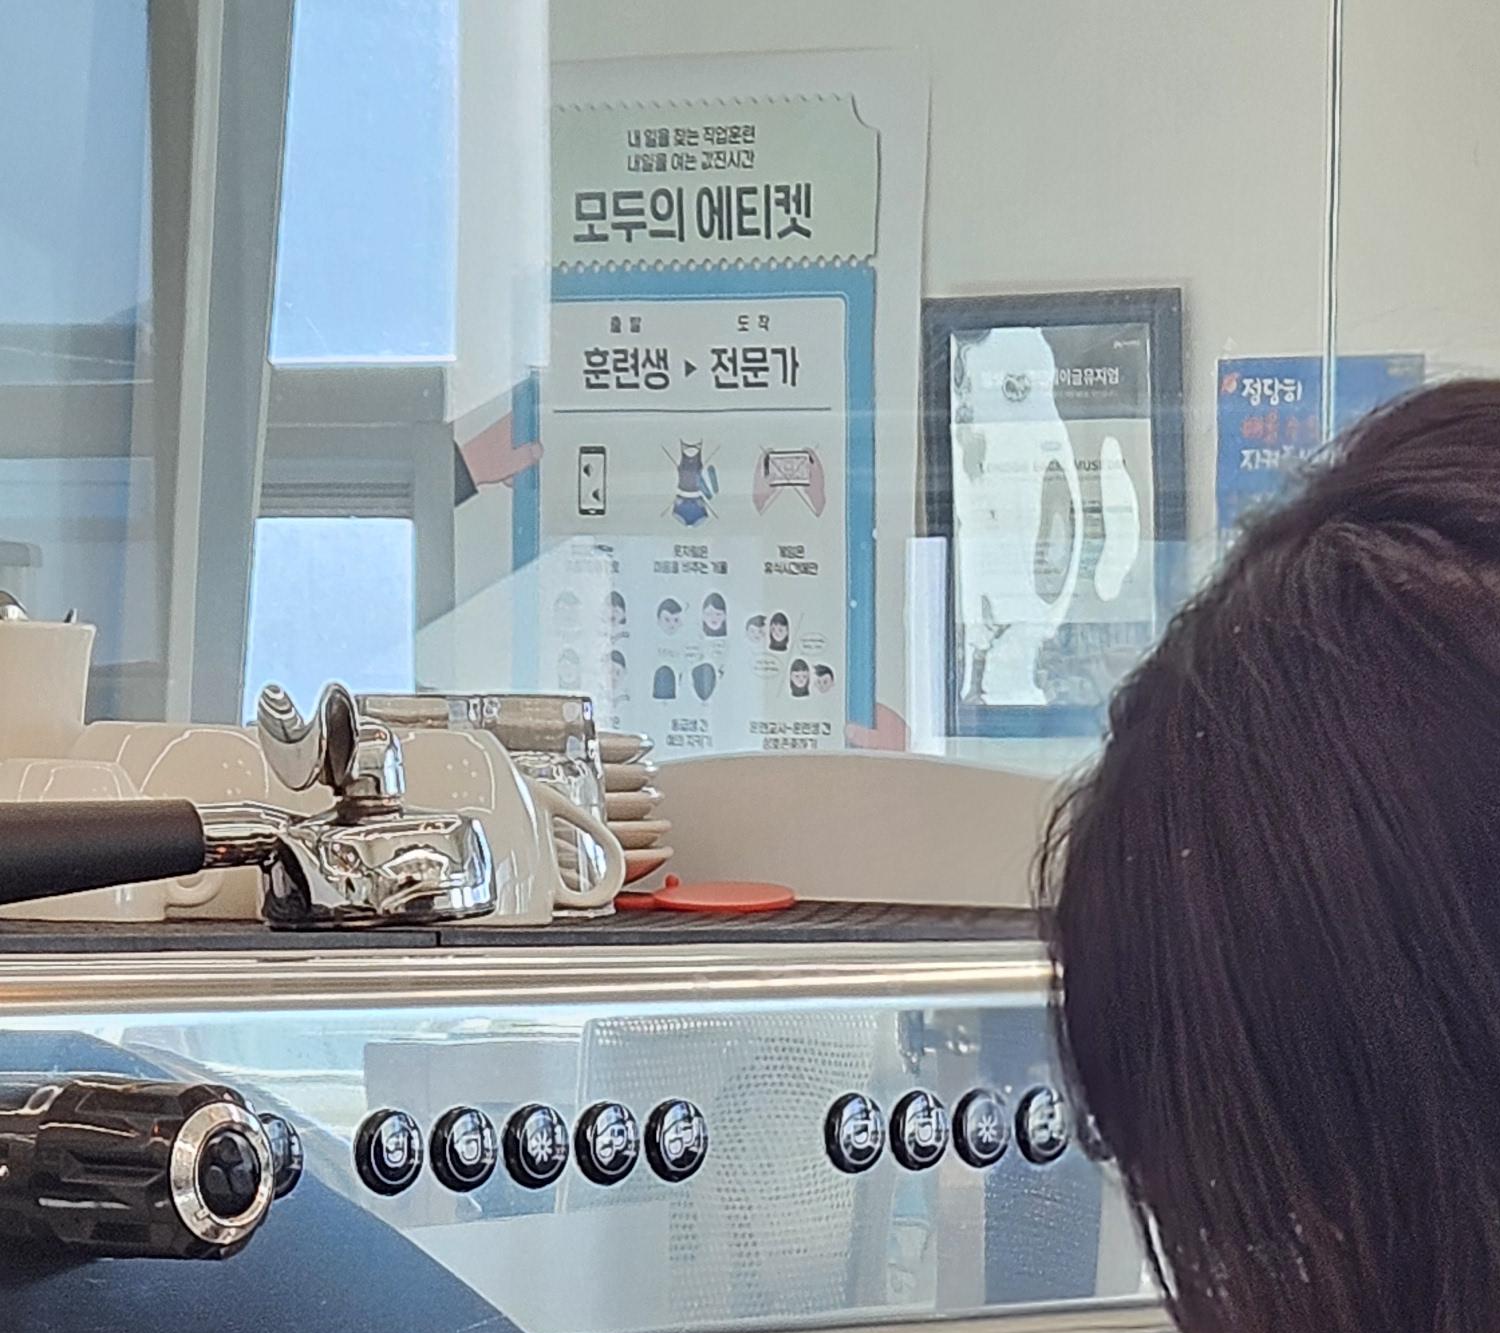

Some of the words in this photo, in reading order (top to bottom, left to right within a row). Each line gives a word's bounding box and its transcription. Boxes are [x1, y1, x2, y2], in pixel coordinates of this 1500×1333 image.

[627, 129, 641, 148] 내
[703, 124, 756, 146] 직업훈련
[671, 152, 697, 172] 여는
[573, 186, 685, 243] 모두의
[696, 182, 812, 241] 에티켓
[583, 347, 670, 390] 훈련생
[710, 345, 800, 389] 전문가
